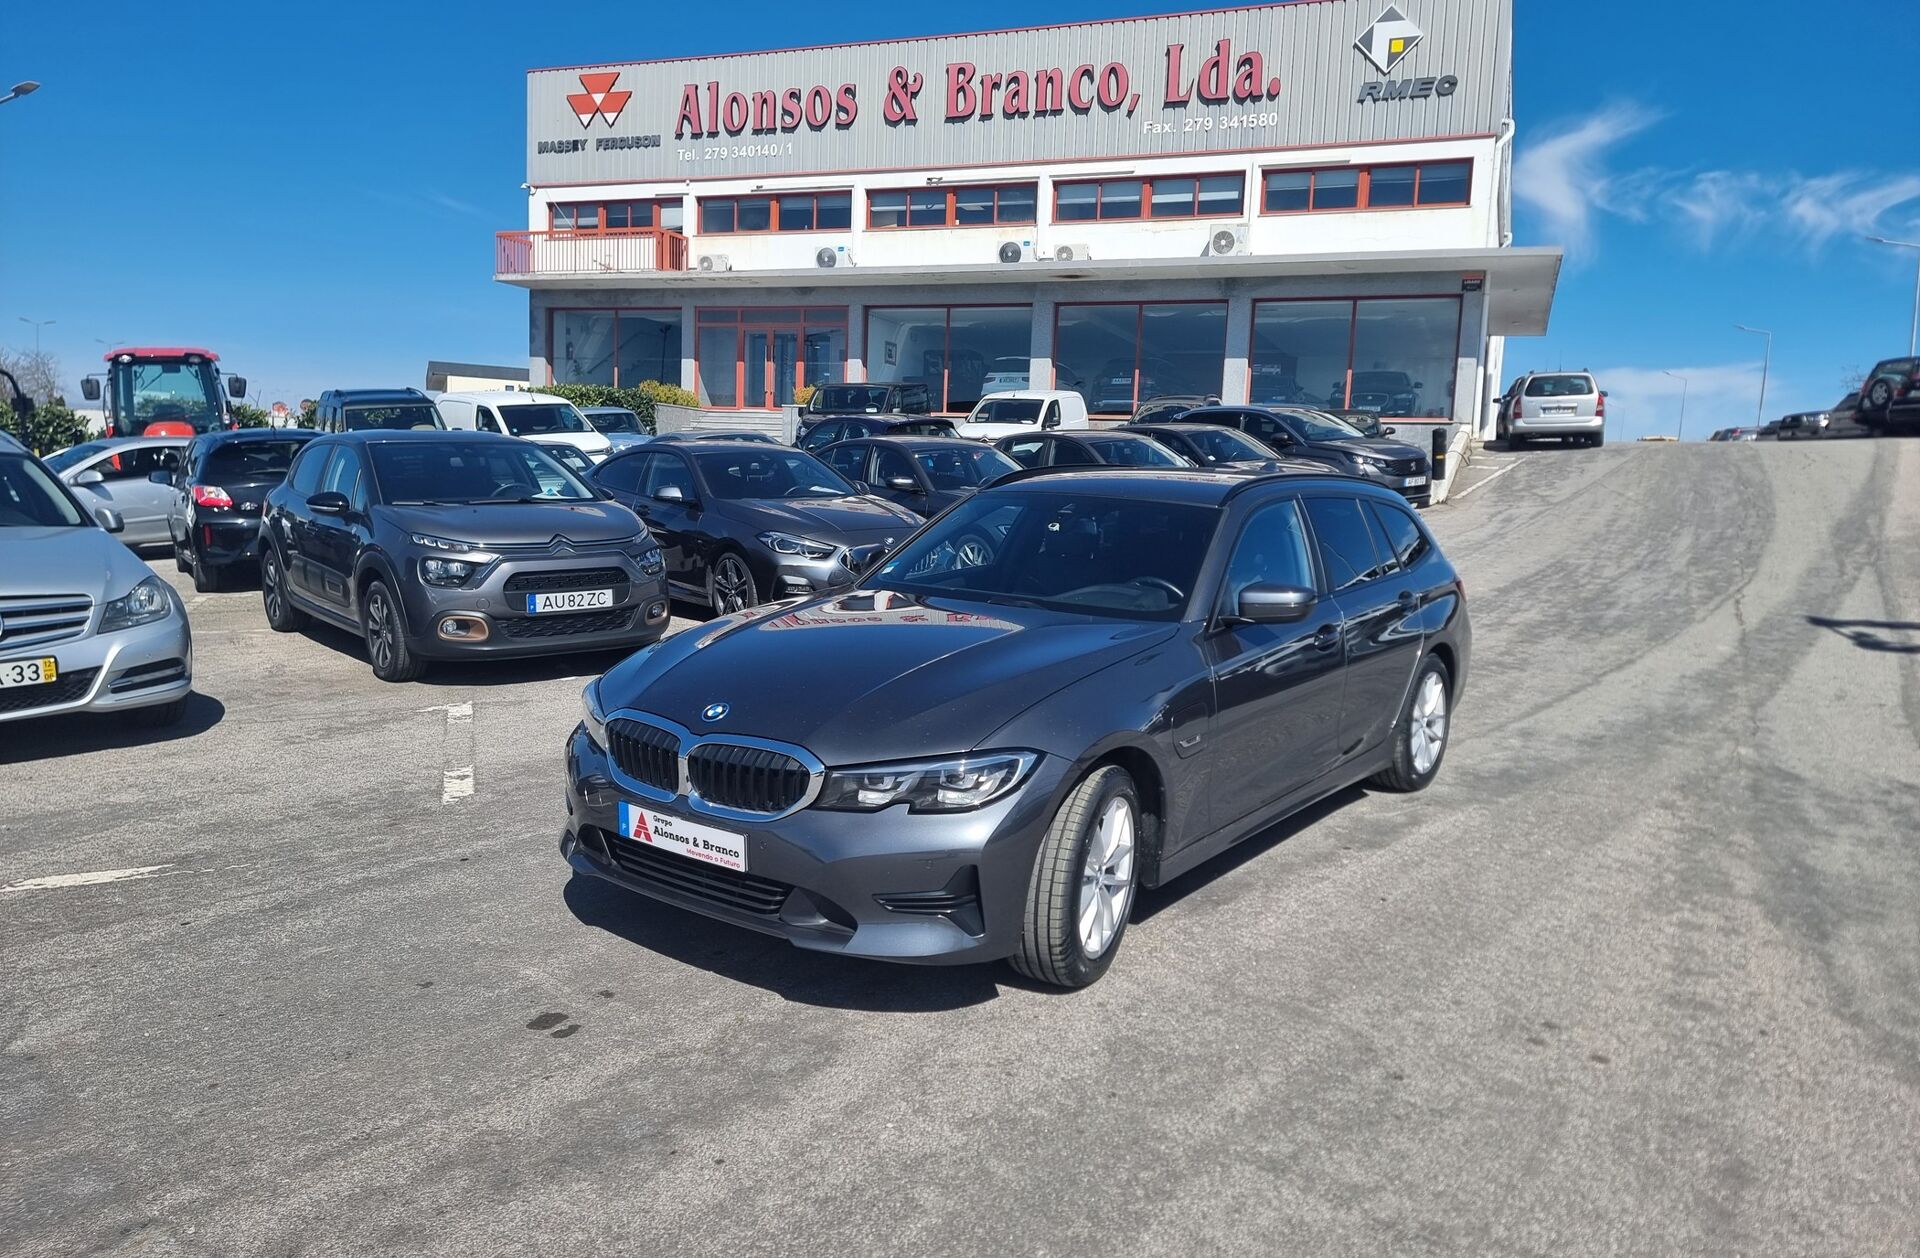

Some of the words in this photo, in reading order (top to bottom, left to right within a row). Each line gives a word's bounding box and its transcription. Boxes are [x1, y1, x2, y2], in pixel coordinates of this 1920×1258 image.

[674, 80, 858, 138] Alonsos
[883, 65, 924, 125] &
[945, 61, 1140, 121] Branco,
[1164, 38, 1282, 105] Lda.
[1143, 120, 1177, 134] Fax.
[1183, 117, 1214, 132] 279
[1219, 112, 1278, 130] 341580
[537, 138, 588, 154] MASSEY
[595, 134, 662, 152] FERGUSON
[677, 148, 700, 161] Tel.
[704, 146, 728, 160] 279
[652, 814, 673, 827] Grupo
[653, 825, 690, 846] Alonsos
[692, 836, 700, 848] &
[702, 839, 740, 859] Branco
[719, 856, 741, 869] Futuro
